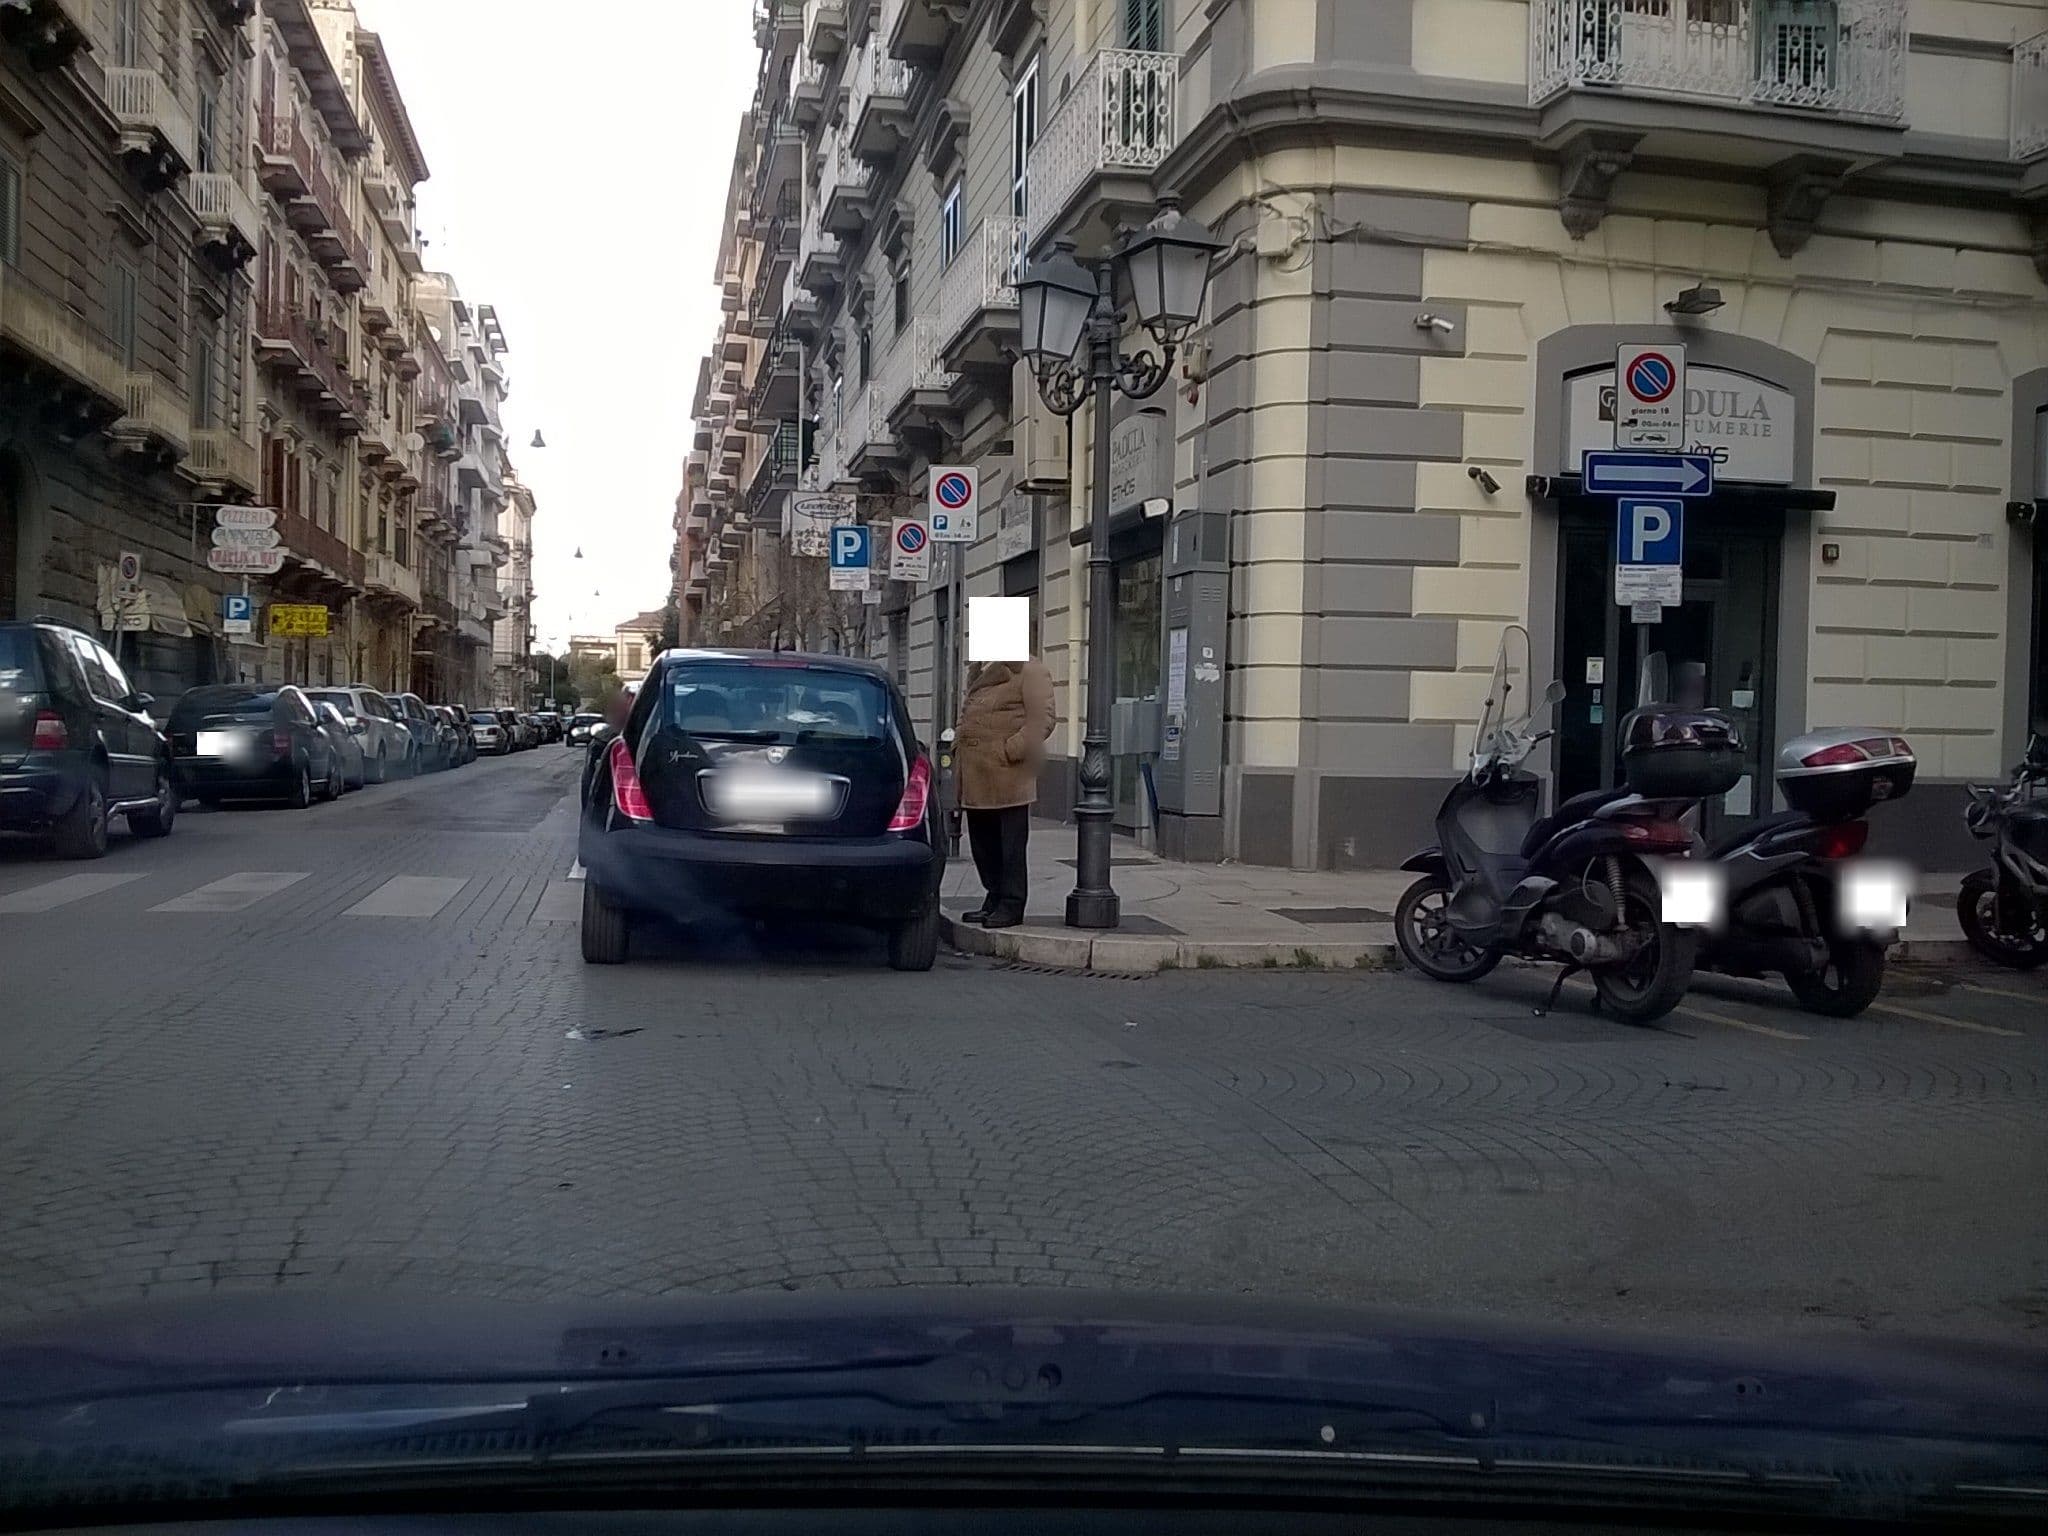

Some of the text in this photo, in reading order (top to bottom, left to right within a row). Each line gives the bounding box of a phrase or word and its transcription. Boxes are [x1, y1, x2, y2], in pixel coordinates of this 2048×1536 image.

[1685, 388, 1772, 421] DULA
[1685, 420, 1772, 438] UMERIE
[1112, 424, 1146, 464] PADULA
[222, 510, 271, 524] PIZZERIA
[936, 516, 946, 528] P
[1631, 505, 1671, 561] P
[836, 530, 862, 565] P
[228, 597, 248, 619] P
